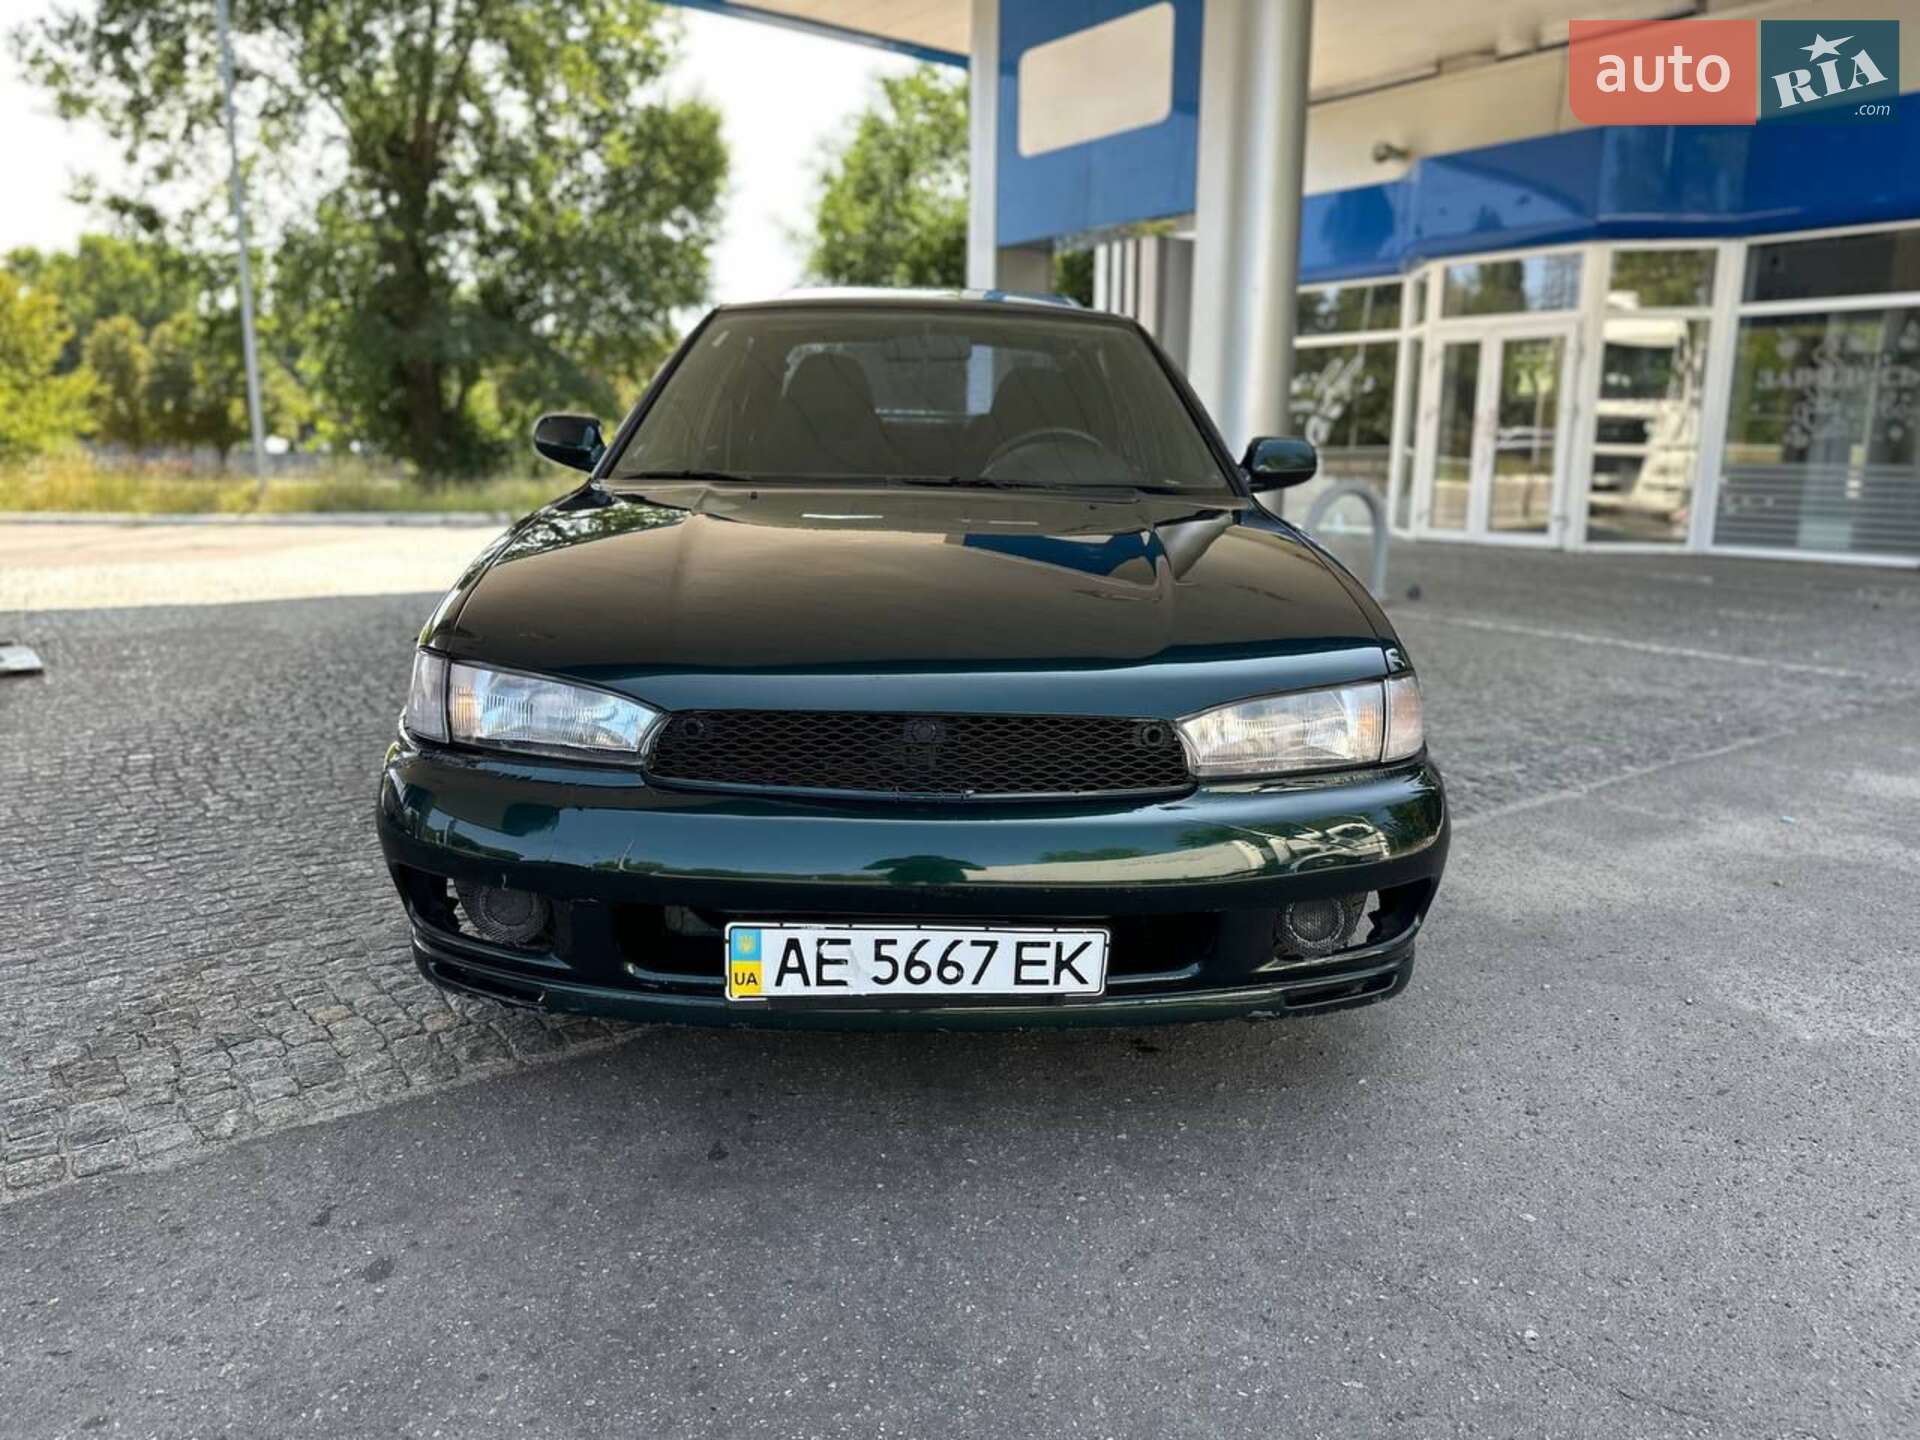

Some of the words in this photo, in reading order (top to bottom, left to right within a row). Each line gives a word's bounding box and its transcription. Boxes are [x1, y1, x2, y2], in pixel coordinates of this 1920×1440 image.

[774, 938, 852, 987] AE
[871, 938, 999, 986] 5667
[1012, 940, 1093, 986] EK
[734, 972, 759, 986] UA
